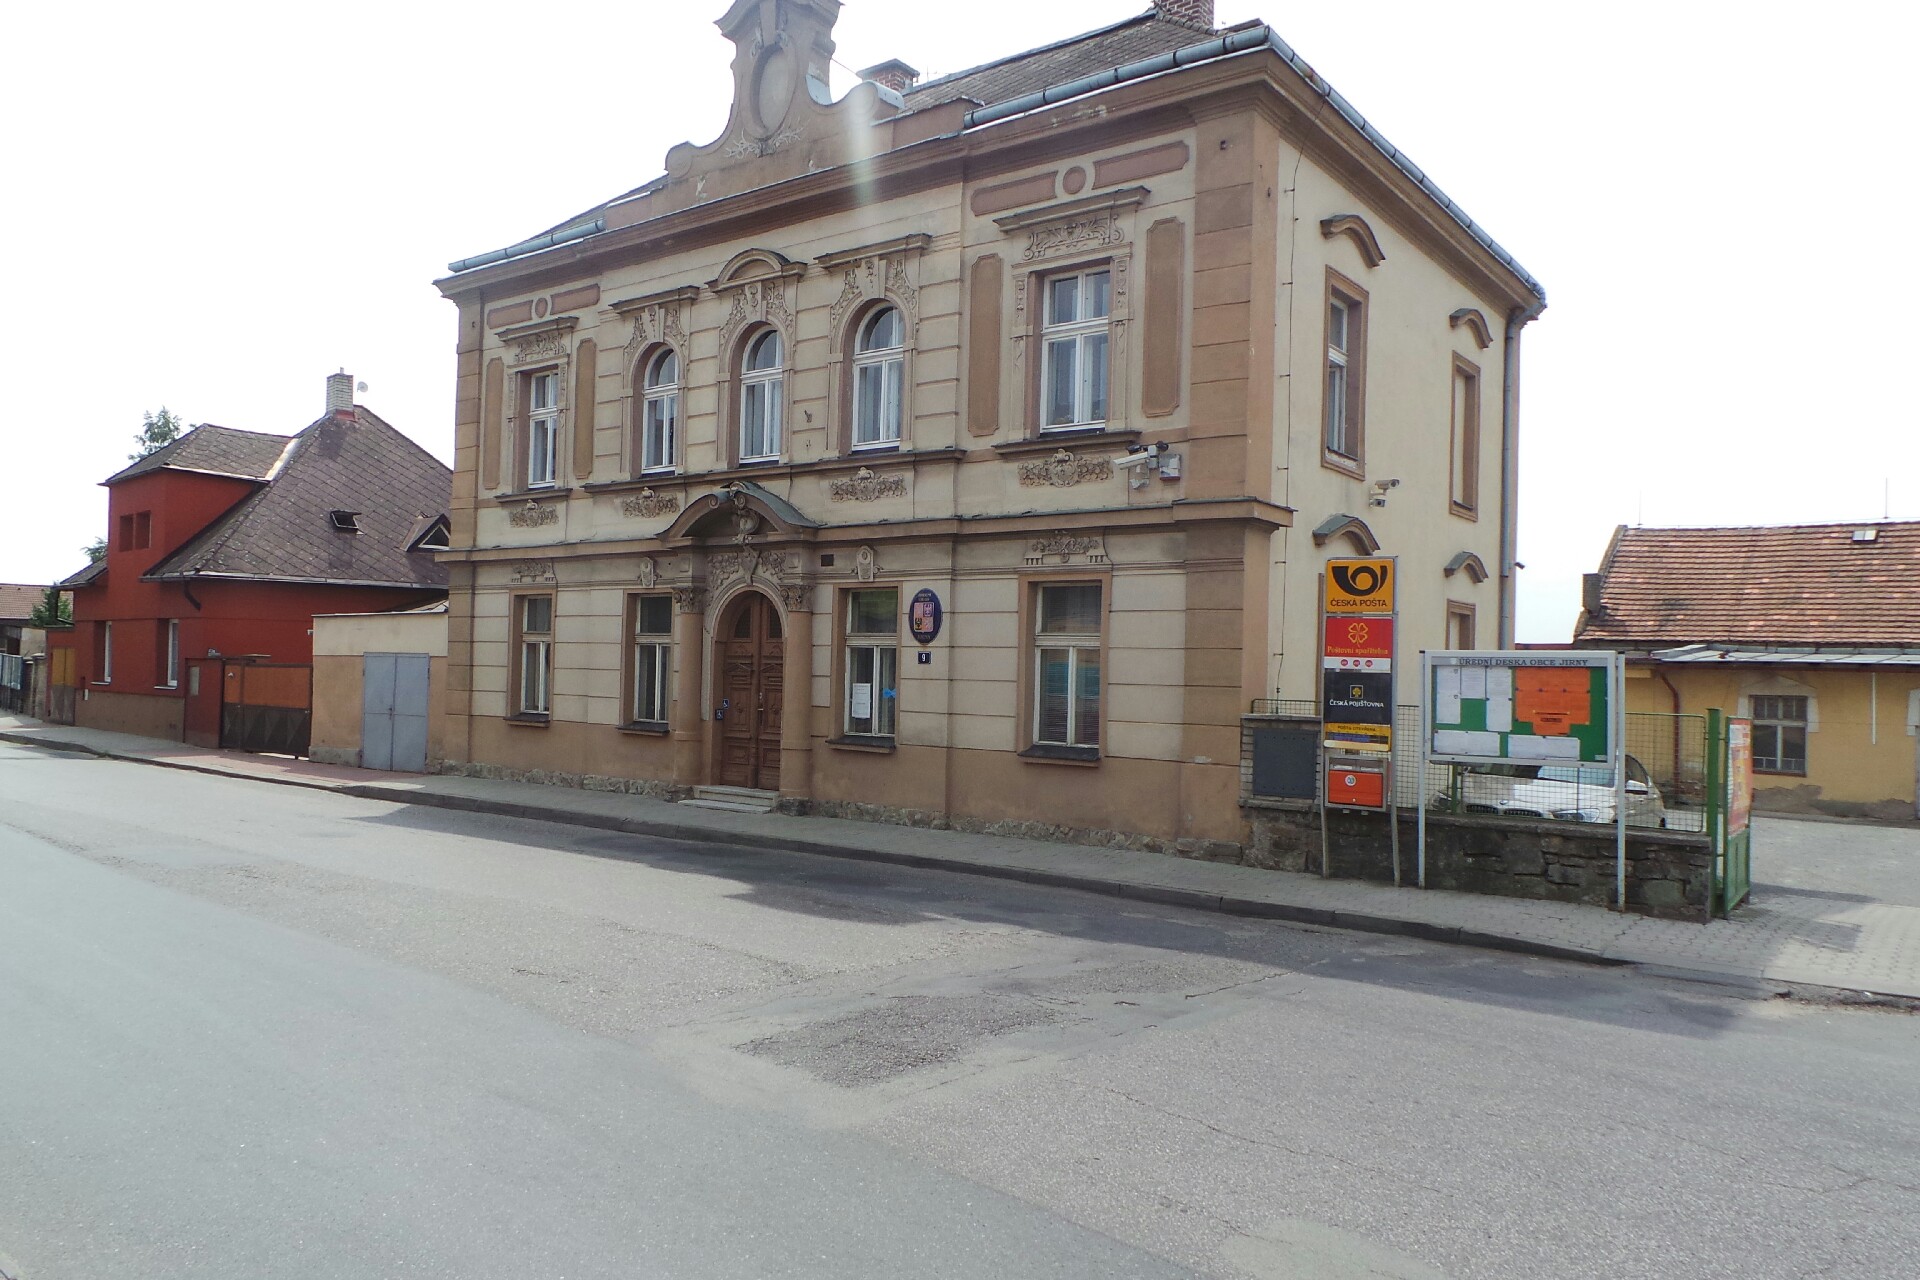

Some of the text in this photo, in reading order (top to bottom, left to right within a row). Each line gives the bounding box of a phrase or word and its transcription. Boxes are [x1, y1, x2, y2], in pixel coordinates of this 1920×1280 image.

[1330, 598, 1387, 607] ČESKÁ POŠTA
[921, 653, 926, 662] 9
[1495, 658, 1527, 666] DESKA
[1529, 658, 1556, 666] OBCE
[1559, 658, 1589, 666] JIRNY
